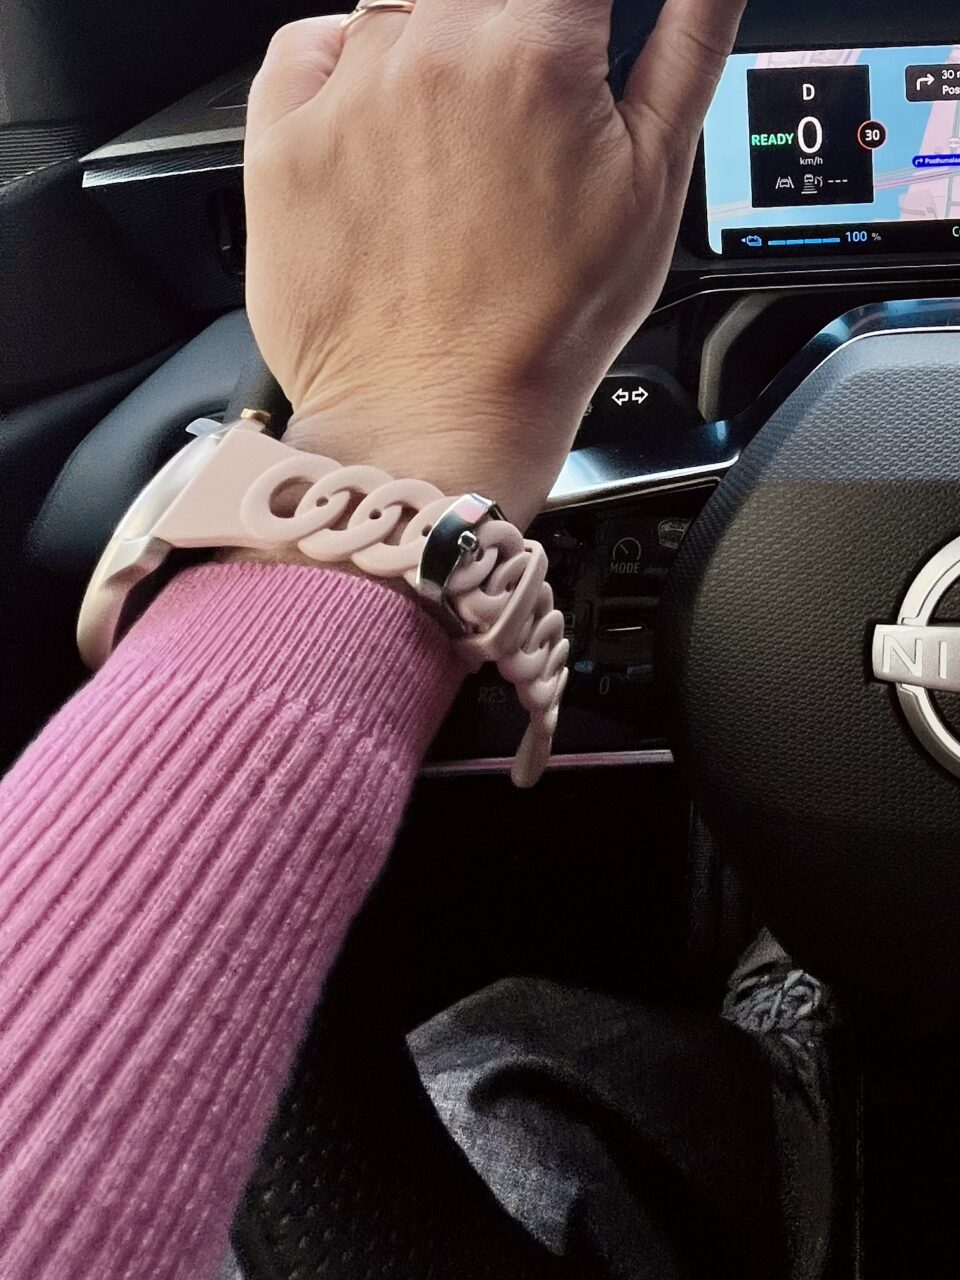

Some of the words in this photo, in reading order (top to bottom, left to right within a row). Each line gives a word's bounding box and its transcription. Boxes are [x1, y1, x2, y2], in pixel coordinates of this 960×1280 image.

[941, 70, 955, 79] 30
[802, 83, 815, 101] D
[751, 133, 794, 146] READY
[797, 116, 823, 154] 0
[864, 129, 881, 142] 30
[799, 156, 824, 166] km/h
[845, 231, 867, 242] 100
[871, 233, 881, 241] %
[609, 562, 641, 574] MODE
